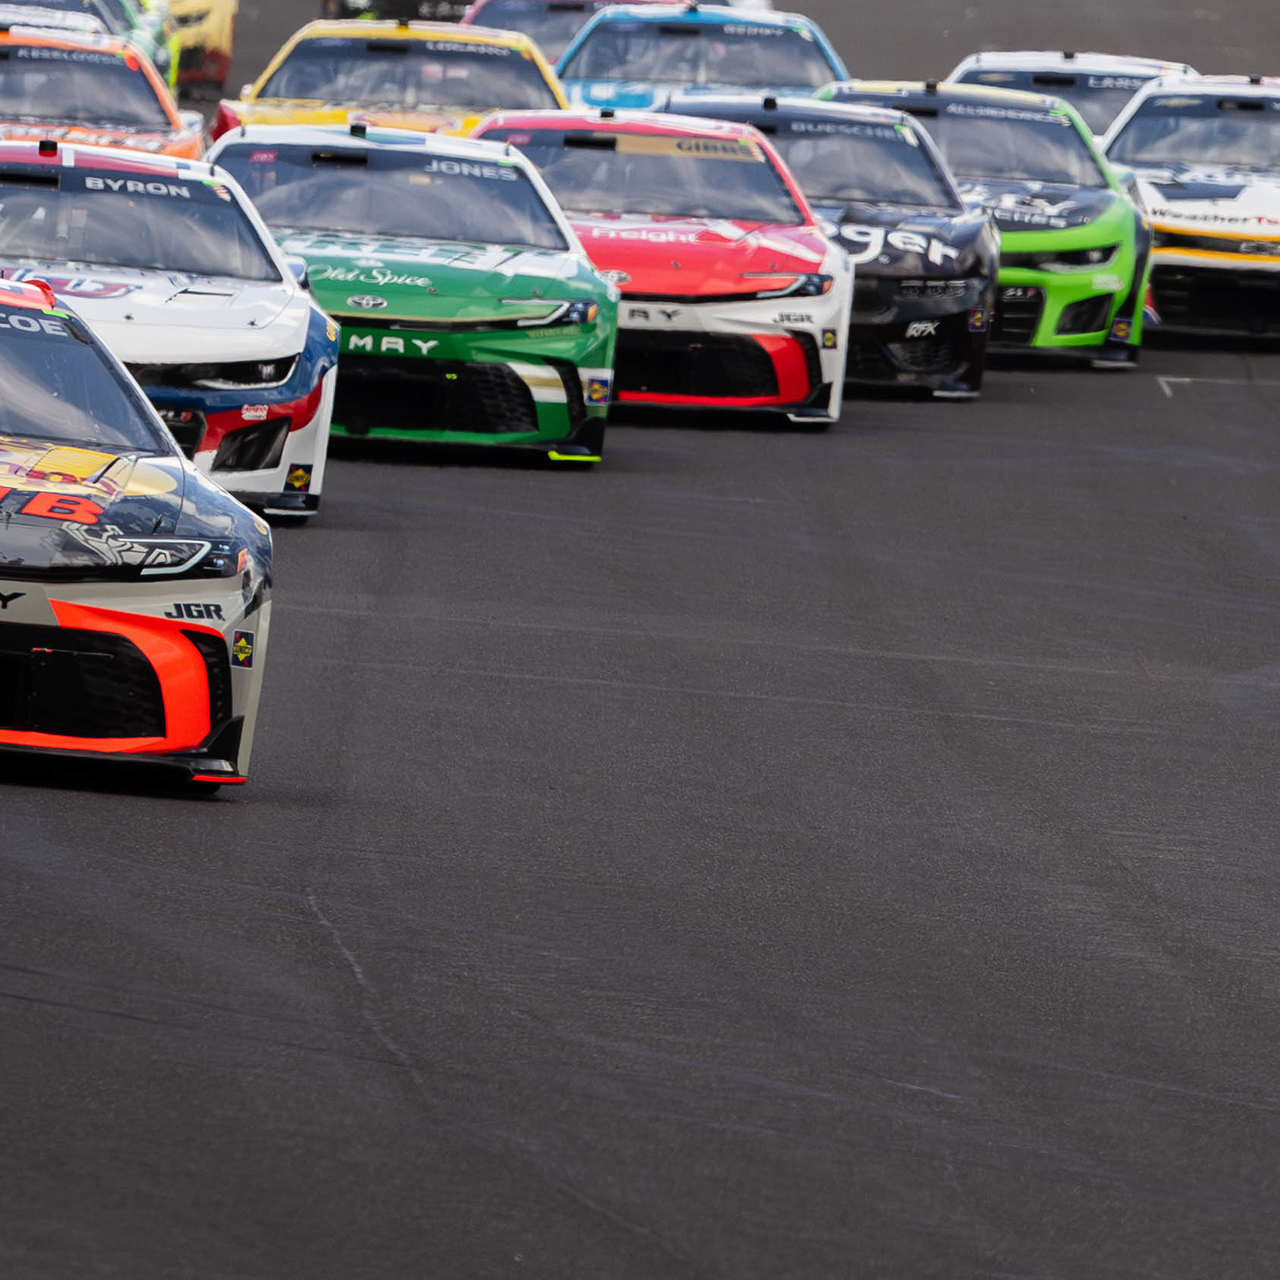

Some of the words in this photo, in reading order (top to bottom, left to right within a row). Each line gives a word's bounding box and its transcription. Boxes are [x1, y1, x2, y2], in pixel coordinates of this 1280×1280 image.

[423, 159, 518, 181] JONES
[84, 176, 191, 199] BYRON
[307, 263, 360, 283] Old
[359, 267, 433, 287] Spice
[164, 603, 226, 622] JGR
